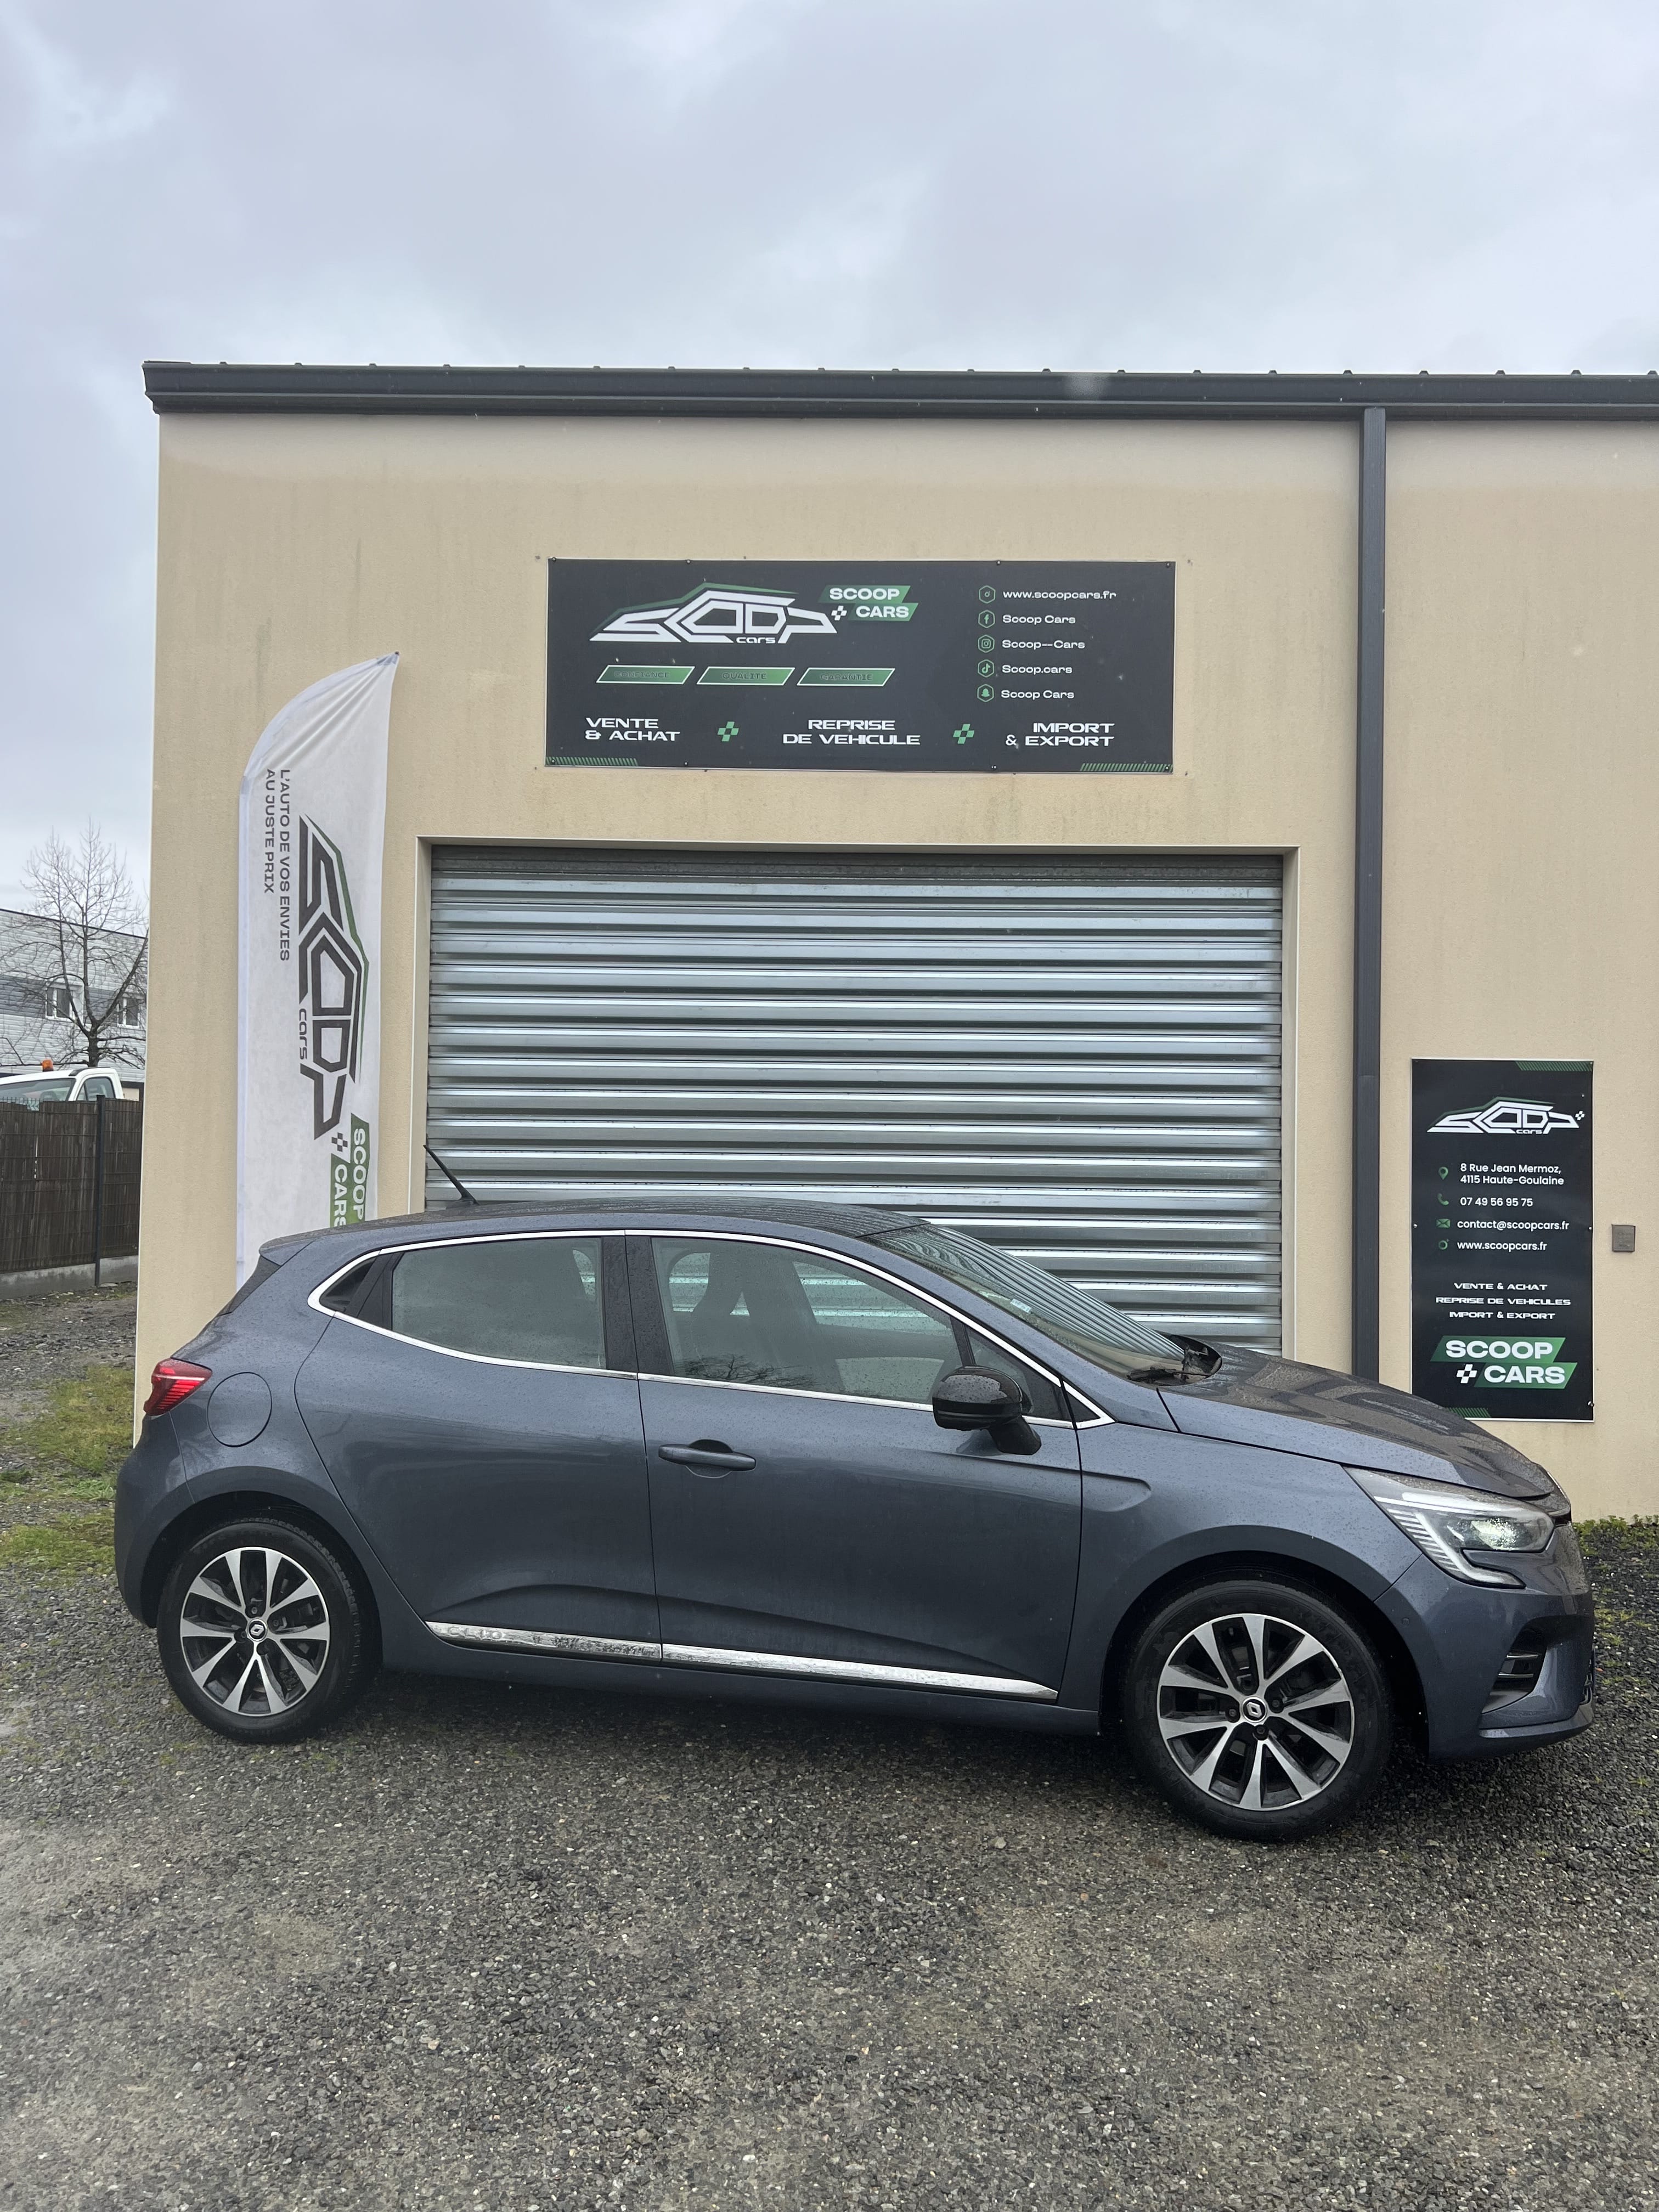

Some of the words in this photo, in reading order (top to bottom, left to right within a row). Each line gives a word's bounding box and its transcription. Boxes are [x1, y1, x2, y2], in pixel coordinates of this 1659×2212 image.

[830, 588, 900, 600] SCOOP
[1003, 590, 1116, 601] www.scoopcars.fr
[856, 606, 909, 618] CARS
[1002, 614, 1042, 625] Scoop
[1045, 615, 1076, 624] Cars
[613, 670, 671, 679] CONFIANCE
[1002, 664, 1073, 675] Scoop.cars
[721, 672, 768, 680] QUALITE
[820, 673, 873, 681] GARANTIE
[1001, 689, 1041, 700] Scoop
[1043, 690, 1075, 699] Cars
[585, 718, 659, 729] VENTE
[808, 719, 895, 731] REPRISE
[1033, 722, 1115, 733] IMPORT
[585, 731, 601, 741] &
[608, 730, 680, 742] ACHAT
[782, 733, 812, 744] DE
[819, 734, 921, 746] VEHICULE
[1005, 735, 1017, 746] &
[1025, 736, 1115, 747] EXPORT
[266, 769, 275, 791] AU
[280, 769, 290, 828] L'AUTO
[265, 794, 275, 848] JUSTE
[280, 831, 290, 853] DE
[264, 851, 274, 894] PRIX
[280, 856, 290, 892] VOS
[280, 896, 290, 961] ENVIES
[298, 1008, 307, 1060] cars
[353, 1128, 366, 1220] SCOOP
[1460, 1163, 1467, 1172] 8
[1469, 1164, 1488, 1172] Rue
[1491, 1164, 1516, 1173] Jean
[1519, 1164, 1561, 1175] Mermoz,
[1460, 1175, 1480, 1183] 4115
[1483, 1176, 1564, 1185] Haute-Goulaine
[1460, 1197, 1472, 1206] 07
[1475, 1197, 1488, 1206] 49
[1490, 1198, 1503, 1206] 56
[1505, 1198, 1519, 1206] 95
[1521, 1198, 1533, 1207] 75
[1457, 1220, 1570, 1232] contact@scoopcars.fr
[1457, 1242, 1547, 1252] www.scoopcars.fr
[1446, 1340, 1553, 1359] SCOOP
[1484, 1365, 1565, 1384] CARS
